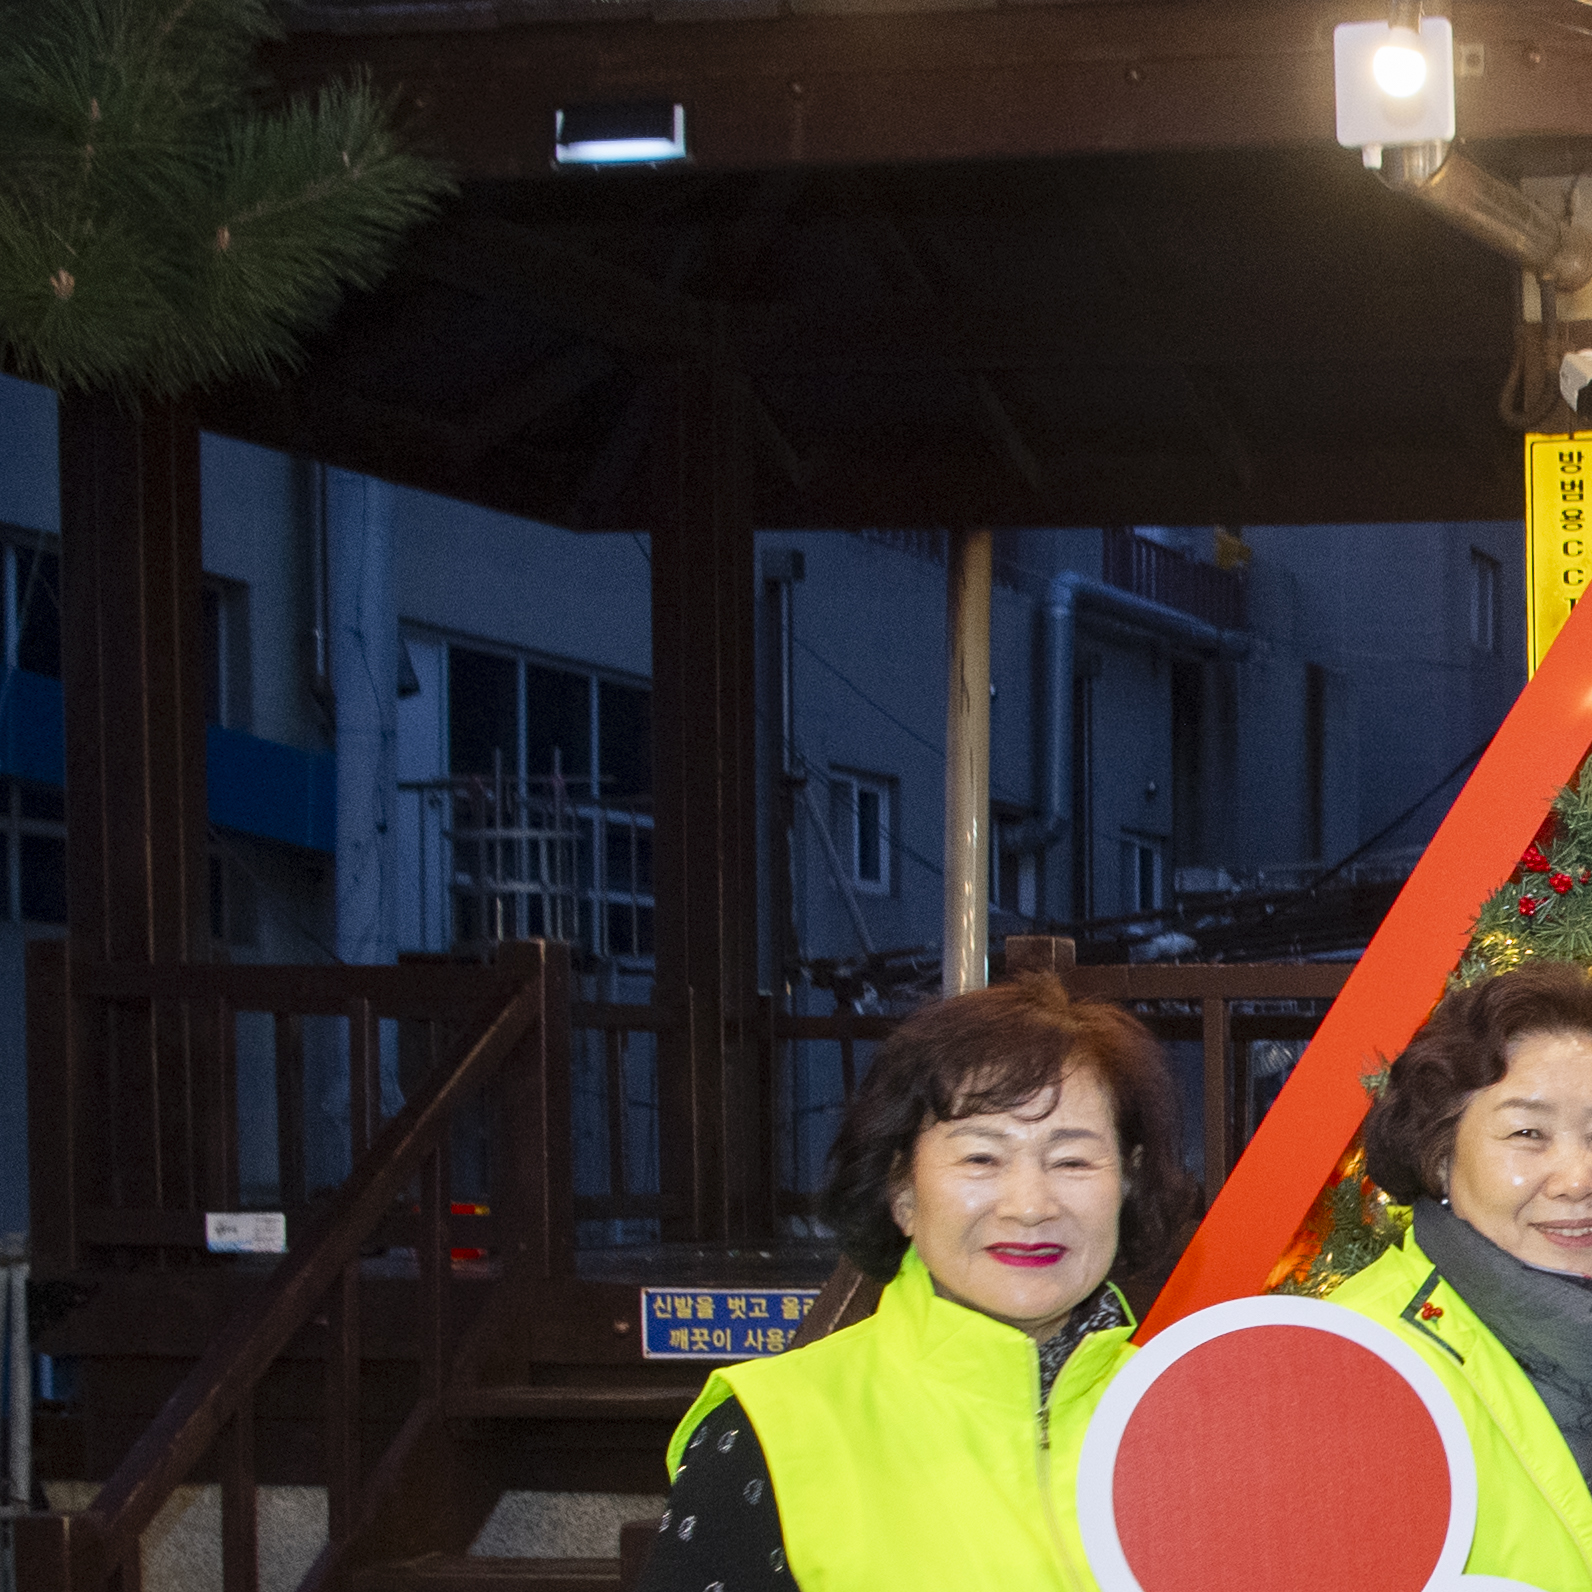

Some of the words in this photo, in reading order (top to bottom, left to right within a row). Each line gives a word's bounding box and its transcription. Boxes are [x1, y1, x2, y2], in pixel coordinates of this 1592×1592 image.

[652, 1295, 716, 1320] 신발을
[727, 1296, 769, 1320] 벗고
[669, 1327, 732, 1352] 깨끗이
